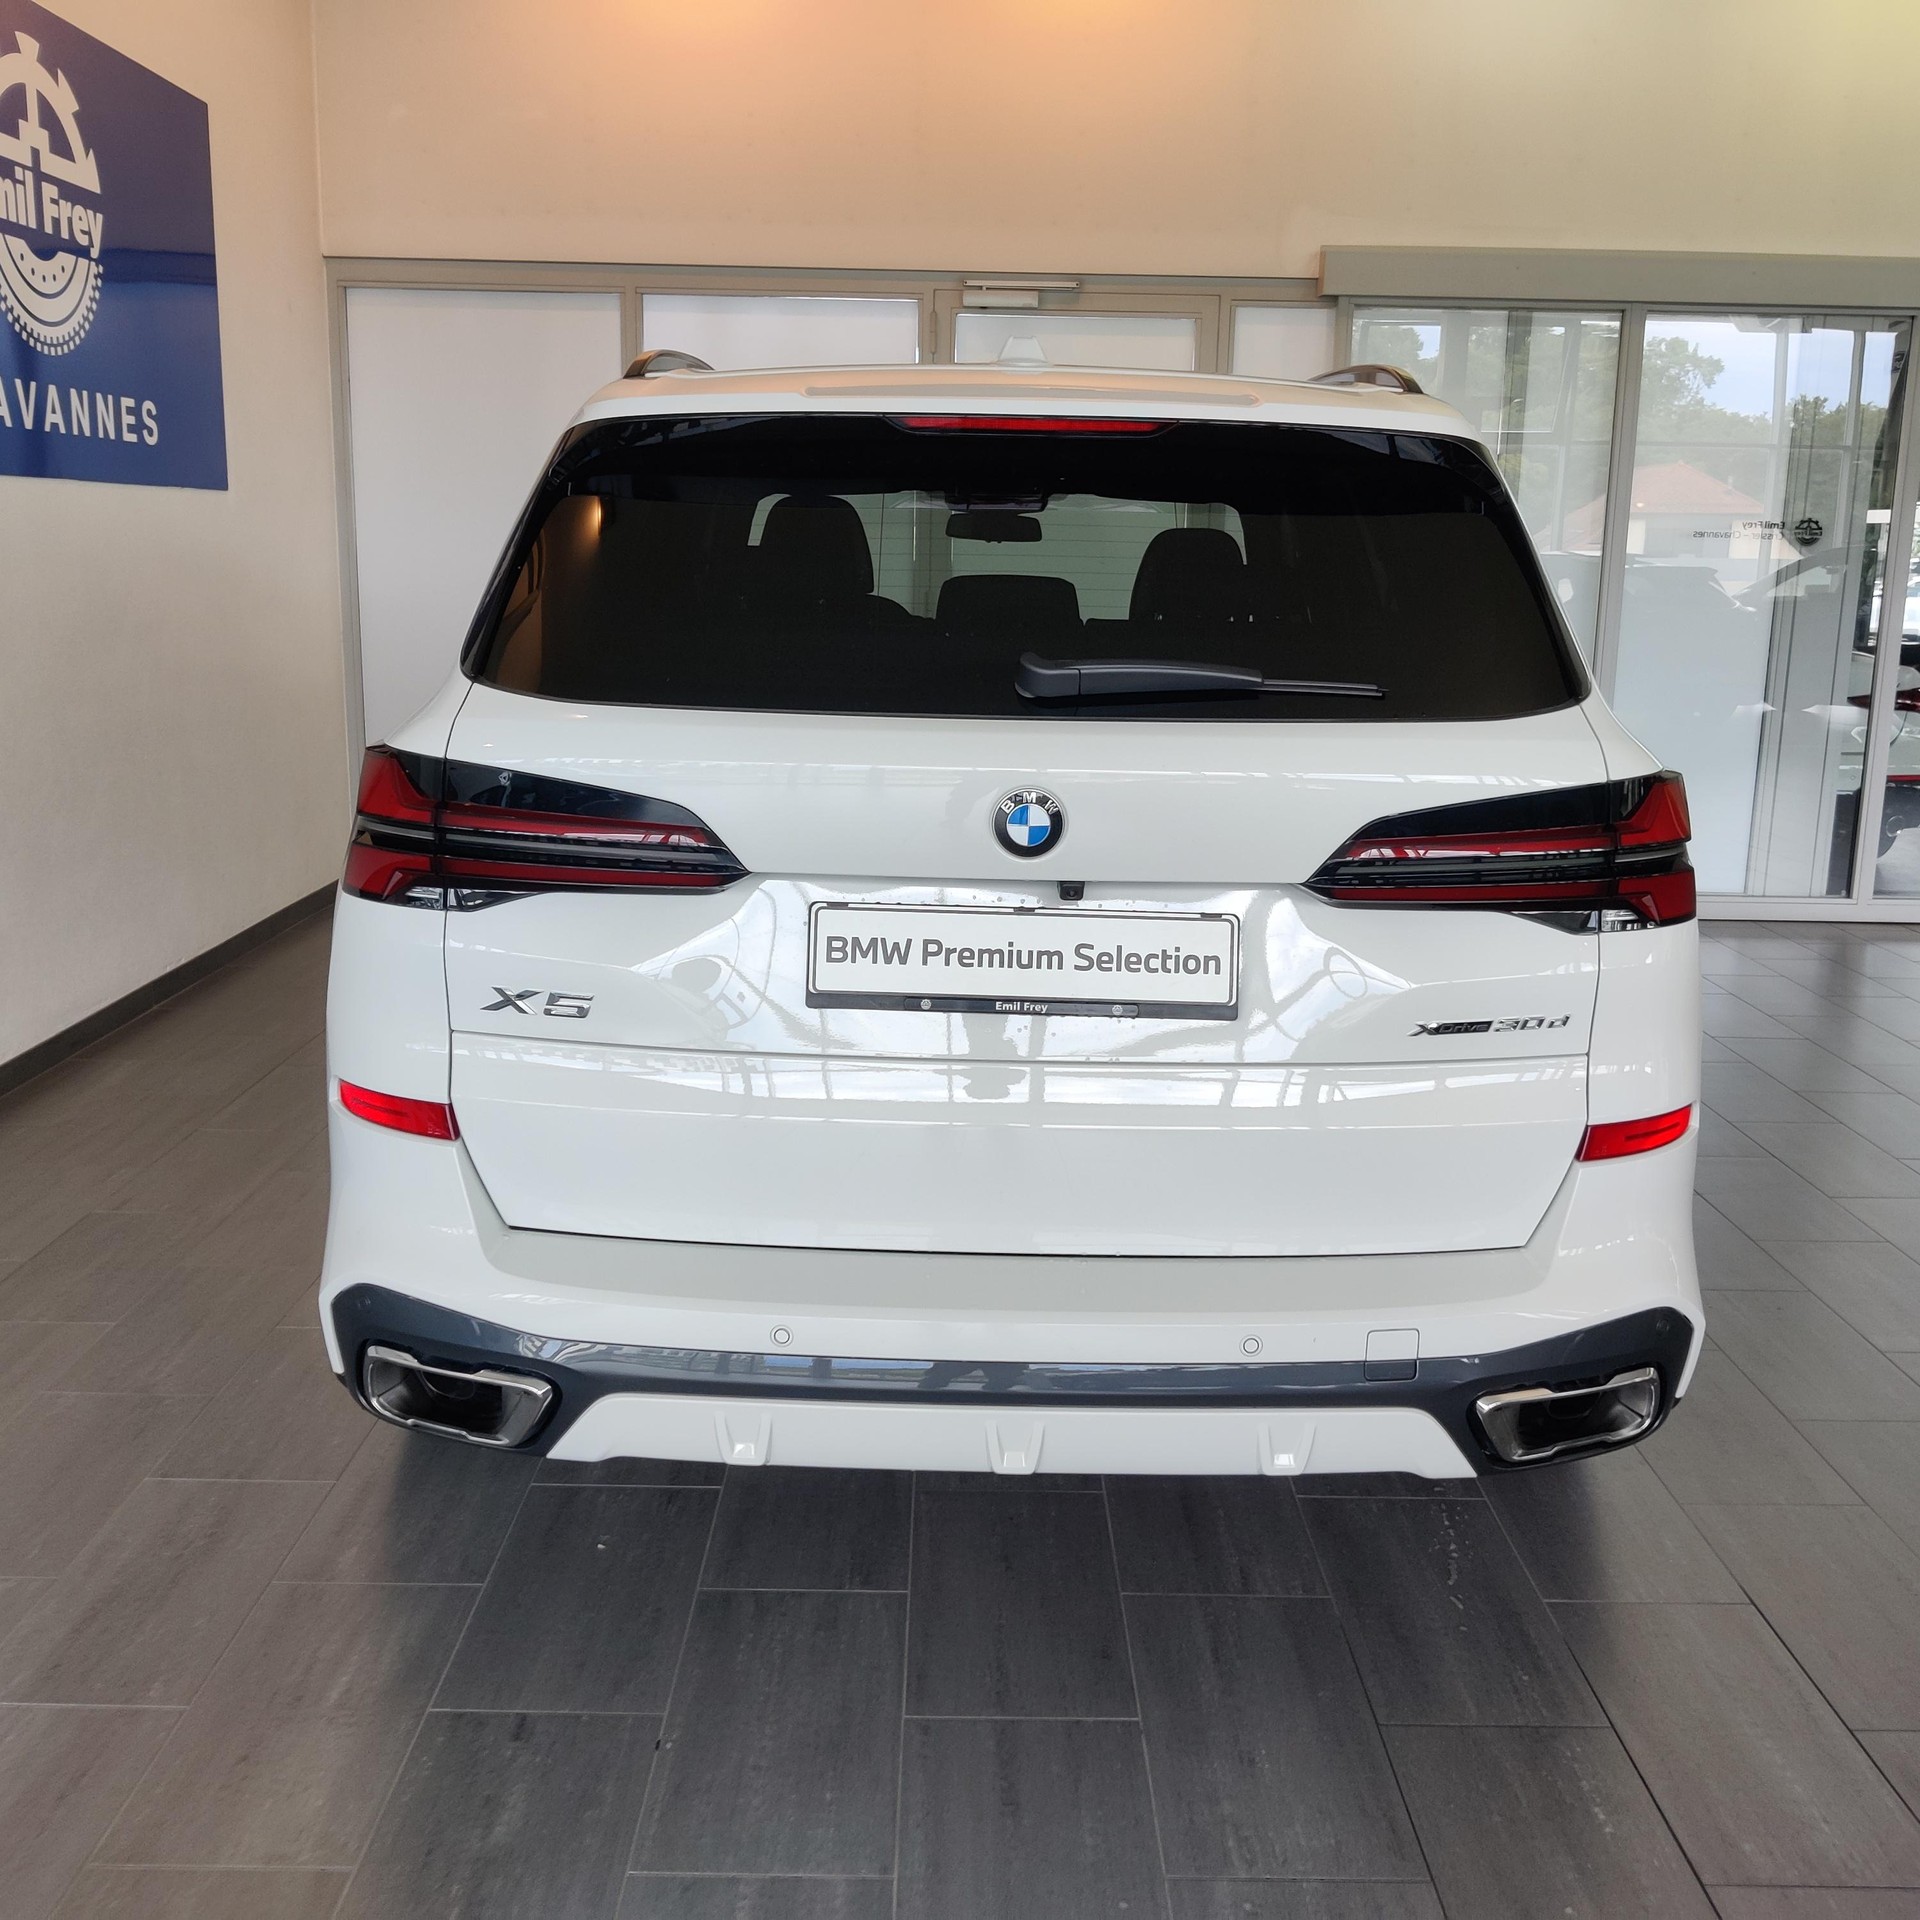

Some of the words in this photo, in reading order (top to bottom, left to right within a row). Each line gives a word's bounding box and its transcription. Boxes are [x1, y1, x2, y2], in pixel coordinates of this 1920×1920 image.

[41, 181, 103, 258] Frey
[1000, 791, 1059, 815] BMW
[825, 935, 912, 966] BMW
[921, 938, 1064, 971] Premium
[1073, 942, 1221, 975] Selection
[480, 986, 595, 1018] X5
[995, 1001, 1020, 1012] Emil
[1023, 1002, 1048, 1013] Frey
